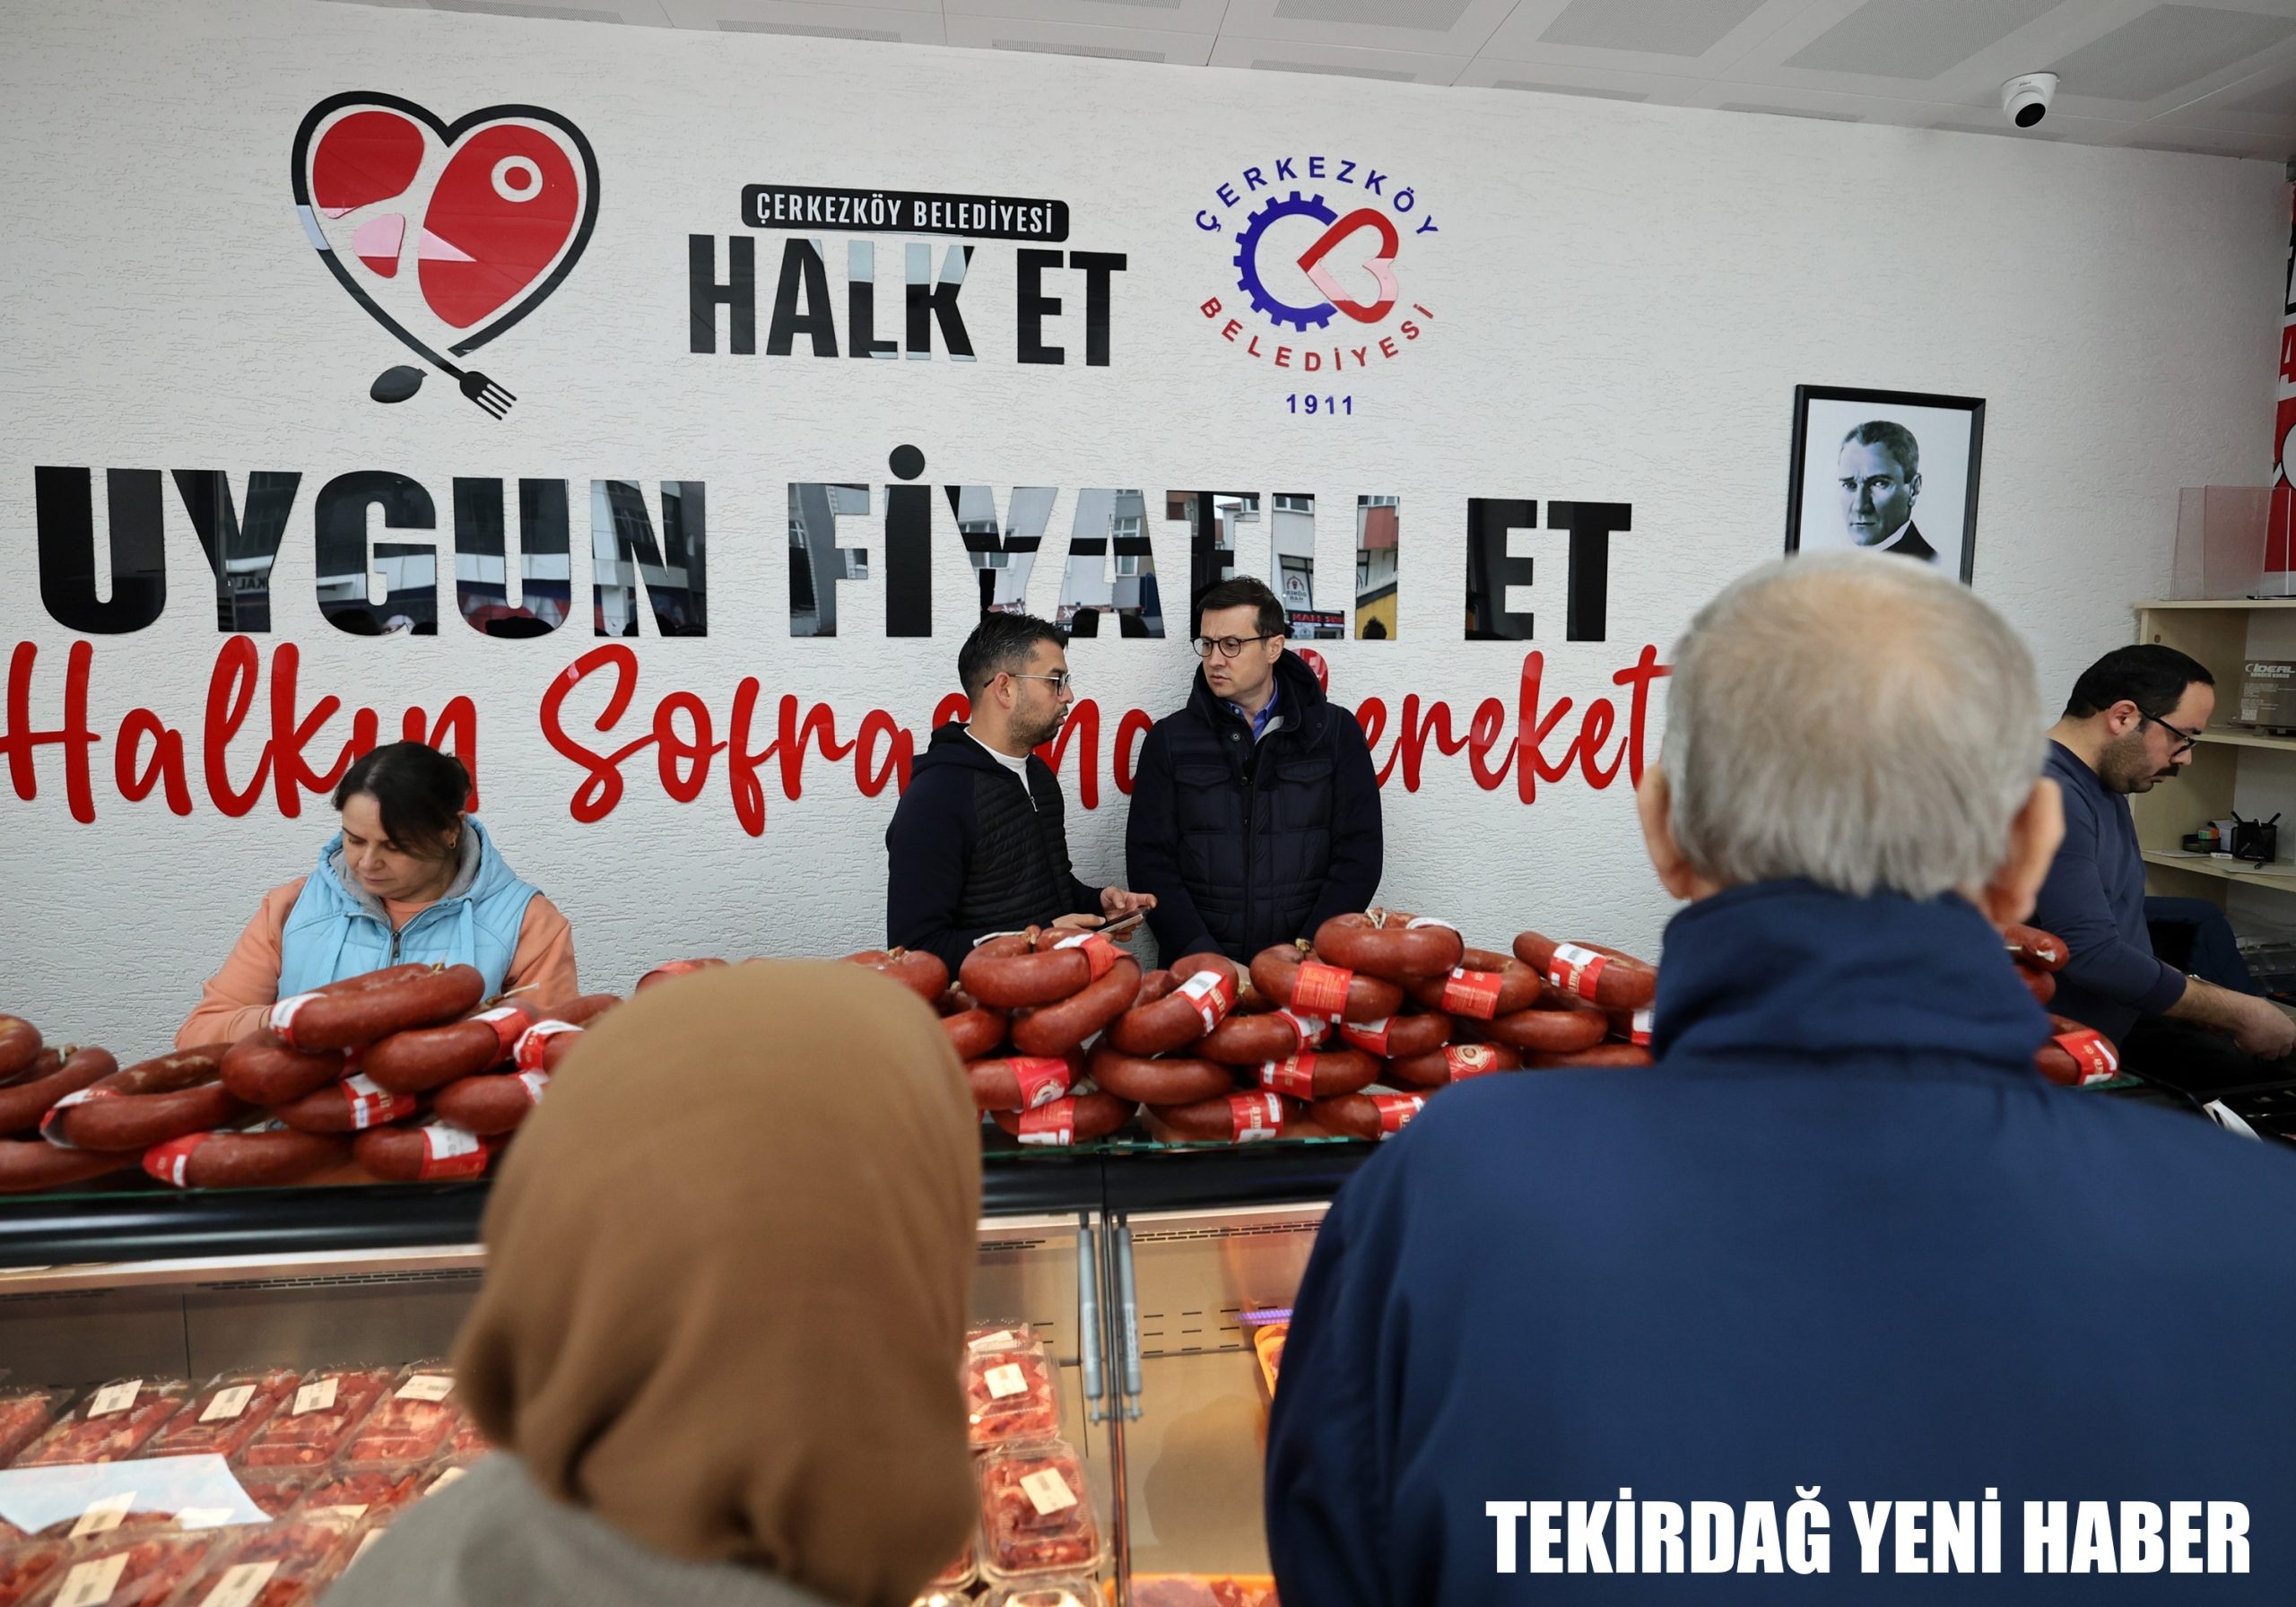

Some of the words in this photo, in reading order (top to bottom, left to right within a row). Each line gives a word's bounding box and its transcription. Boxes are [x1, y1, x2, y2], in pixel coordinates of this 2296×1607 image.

[756, 192, 902, 227] ÇERKEZKÖY
[913, 199, 1053, 234] BELEDİYESİ
[1196, 156, 1439, 236] ÇERKEZKÖY
[689, 233, 976, 362] HALK
[1017, 248, 1127, 367] ET
[1200, 297, 1434, 372] BELEDİYESİ
[1286, 394, 1353, 415] 1911
[34, 465, 709, 639] UYGUN
[1464, 497, 1632, 642] ET
[1287, 644, 1674, 805] ereket
